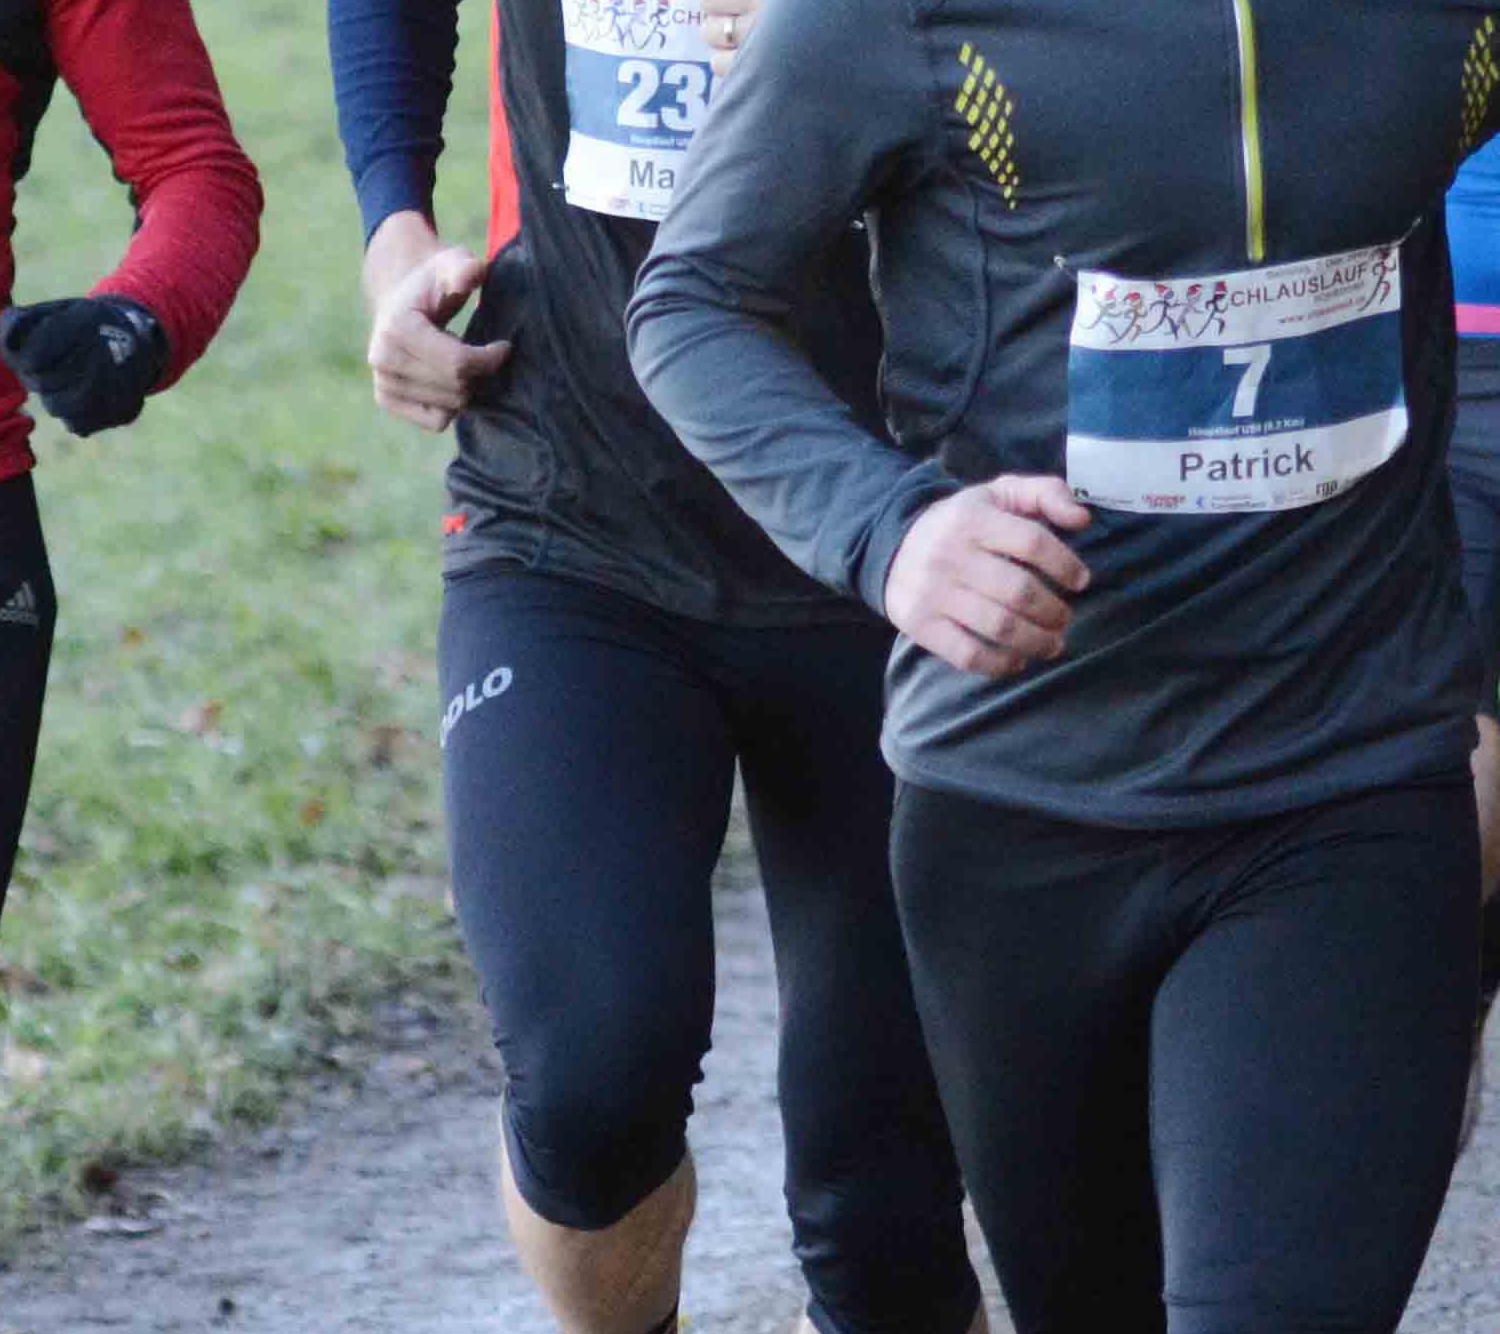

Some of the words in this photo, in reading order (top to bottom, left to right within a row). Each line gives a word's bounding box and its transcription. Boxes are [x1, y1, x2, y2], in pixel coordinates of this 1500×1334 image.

[672, 9, 709, 26] CH
[617, 59, 709, 132] 23
[630, 159, 675, 189] Ma
[1230, 264, 1368, 308] CHLAUSLAUF
[1223, 343, 1272, 417] 7
[1180, 443, 1315, 482] Patrick
[439, 666, 513, 748] DLO
